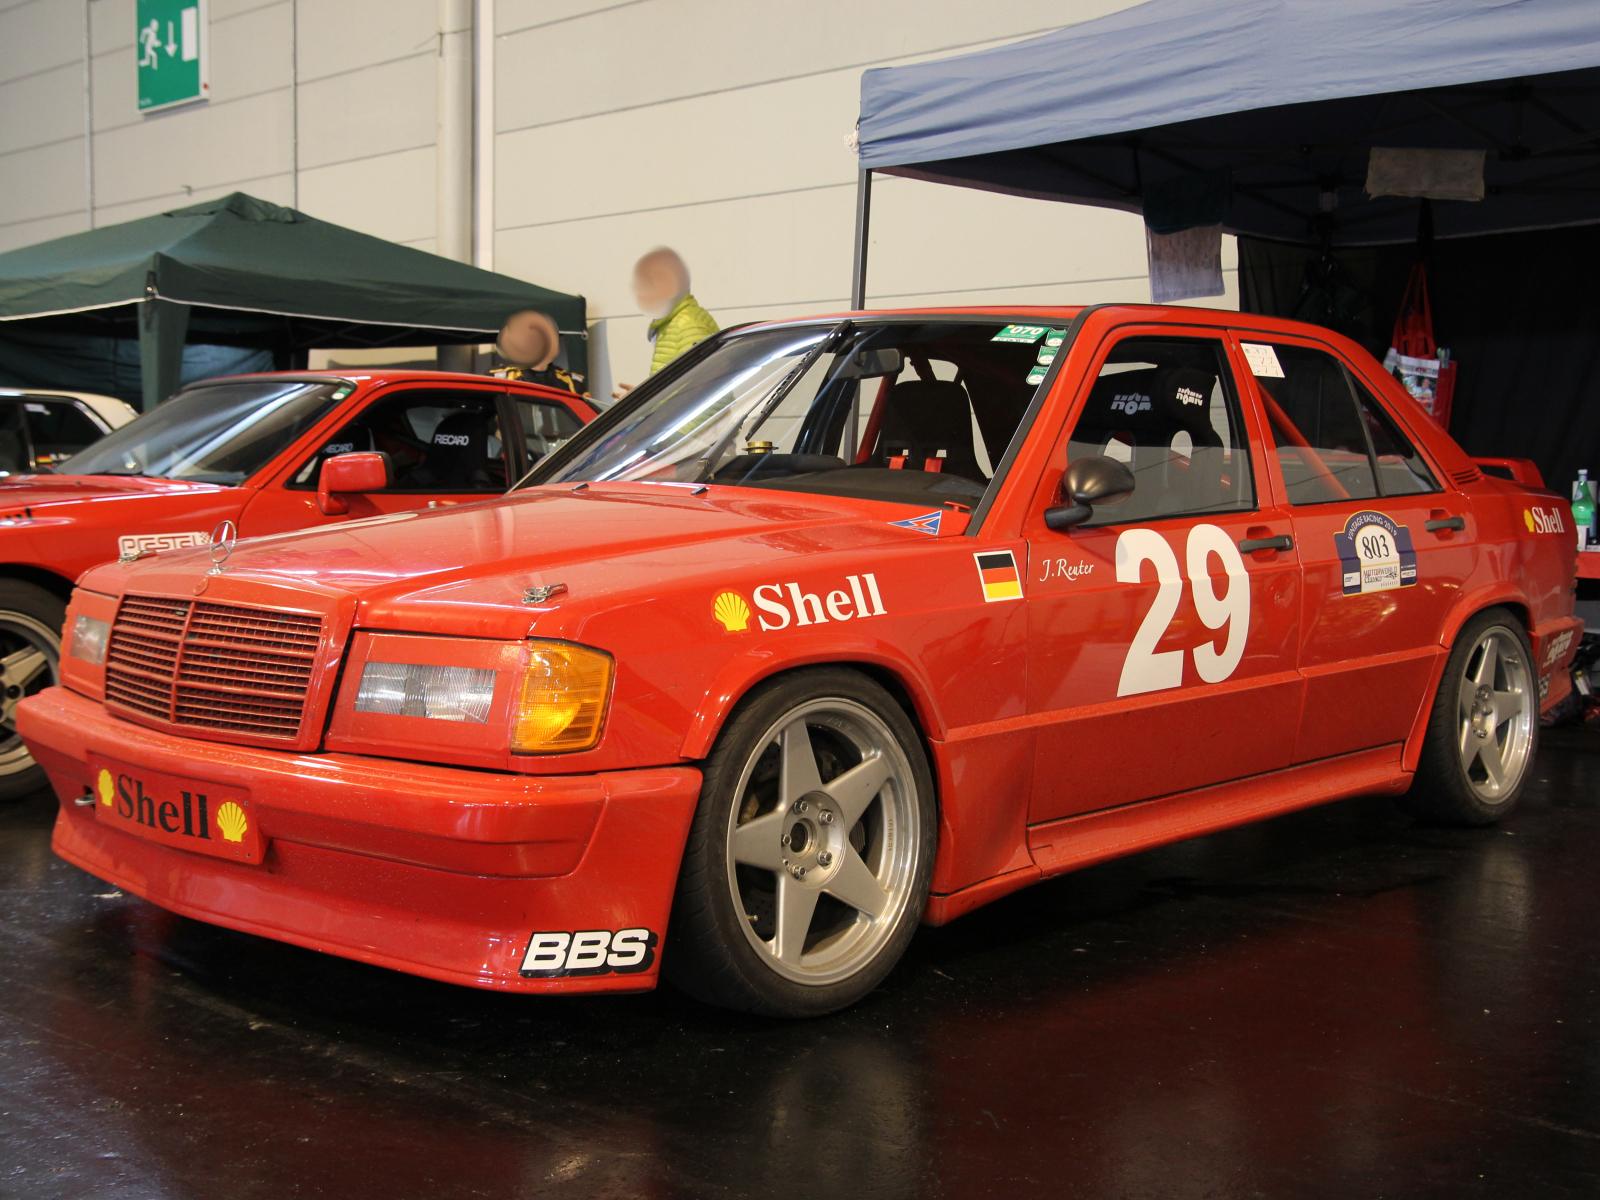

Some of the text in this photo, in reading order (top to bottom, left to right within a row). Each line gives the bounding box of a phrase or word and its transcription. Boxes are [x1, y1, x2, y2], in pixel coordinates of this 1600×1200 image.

[1009, 326, 1045, 335] 070
[434, 434, 469, 446] RECARO
[1347, 514, 1398, 540] VINTAGE RACING 2019
[1531, 506, 1565, 534] Shell
[1362, 534, 1390, 560] 803
[752, 573, 888, 632] Shell
[1115, 524, 1250, 697] 29
[117, 774, 212, 840] Shell
[520, 928, 652, 972] BBS
